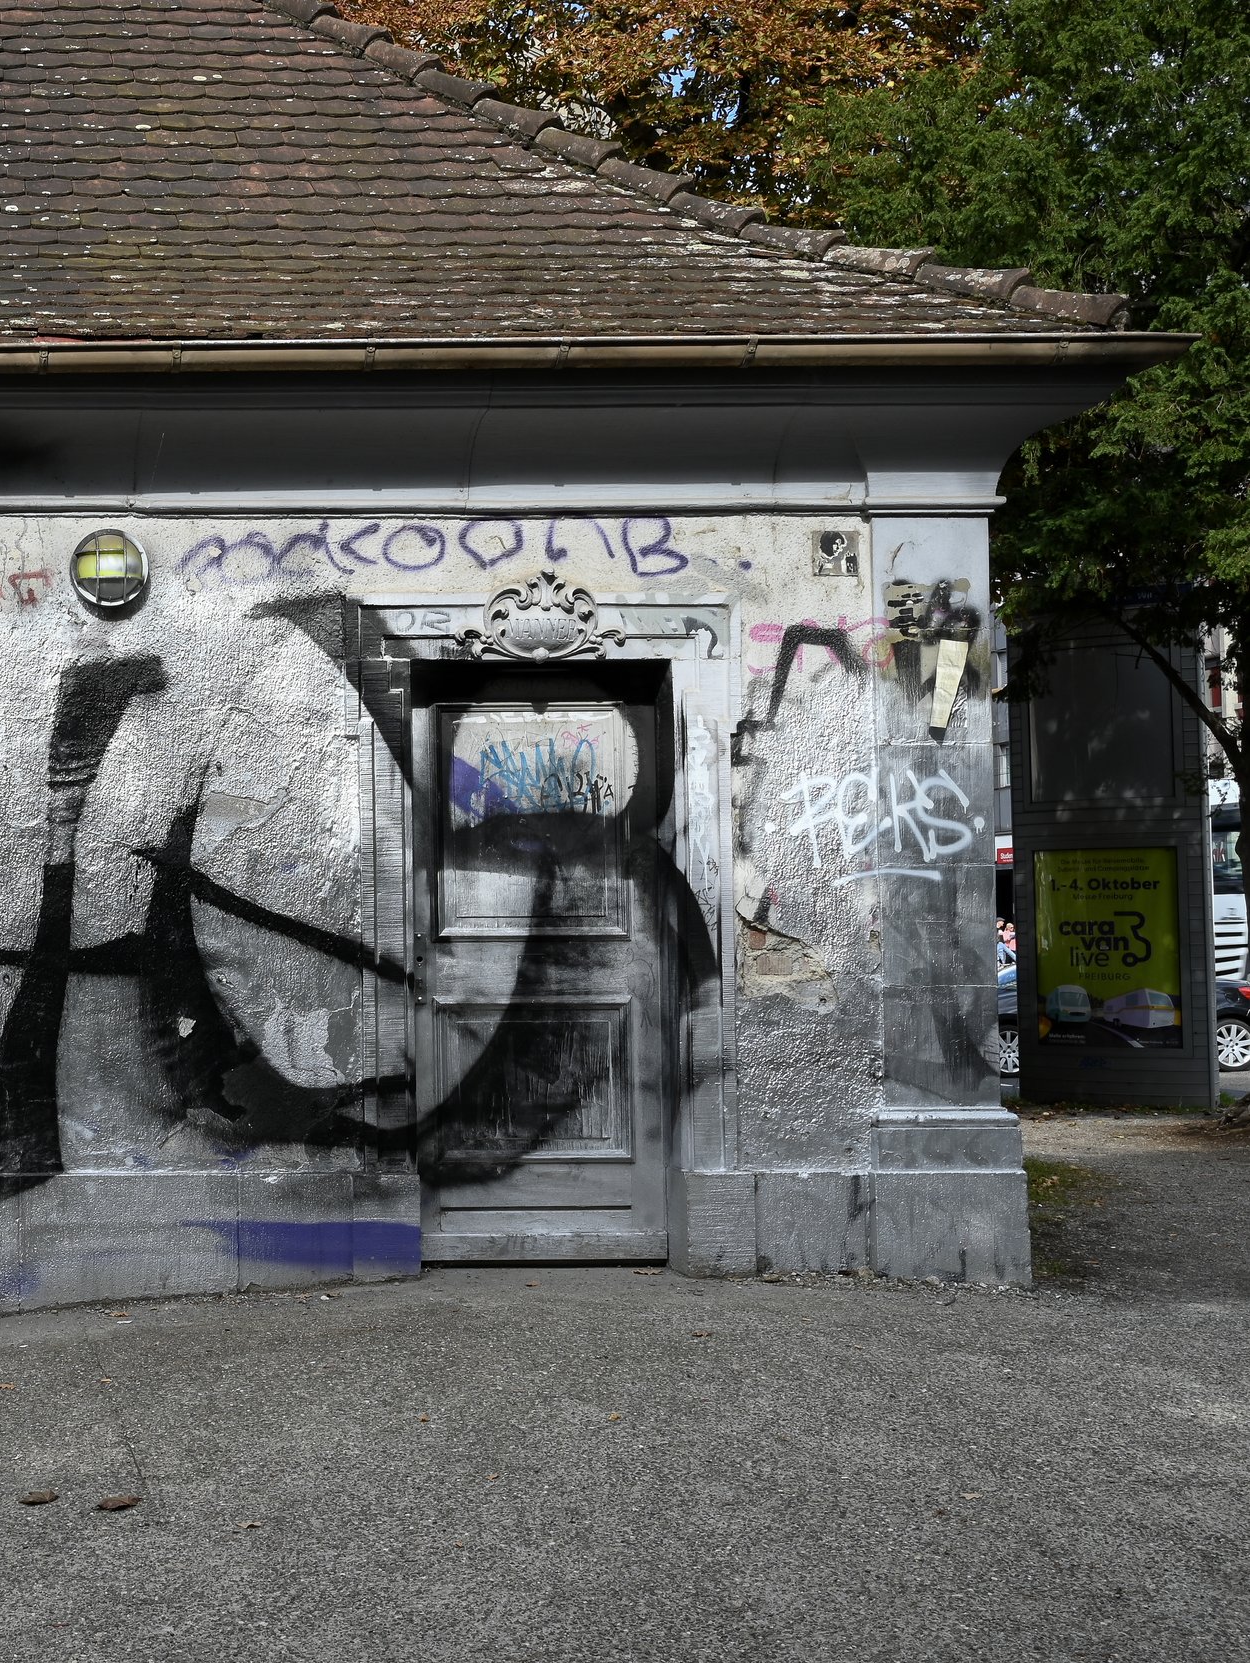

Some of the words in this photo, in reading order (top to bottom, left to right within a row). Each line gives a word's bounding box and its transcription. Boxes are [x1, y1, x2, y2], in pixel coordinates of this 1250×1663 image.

[1087, 877, 1160, 891] Oktober
[1098, 892, 1133, 901] Freiburg
[1059, 920, 1115, 936] cara
[1080, 936, 1129, 951] van
[1070, 946, 1110, 967] live
[1078, 972, 1131, 981] FREIBURG
